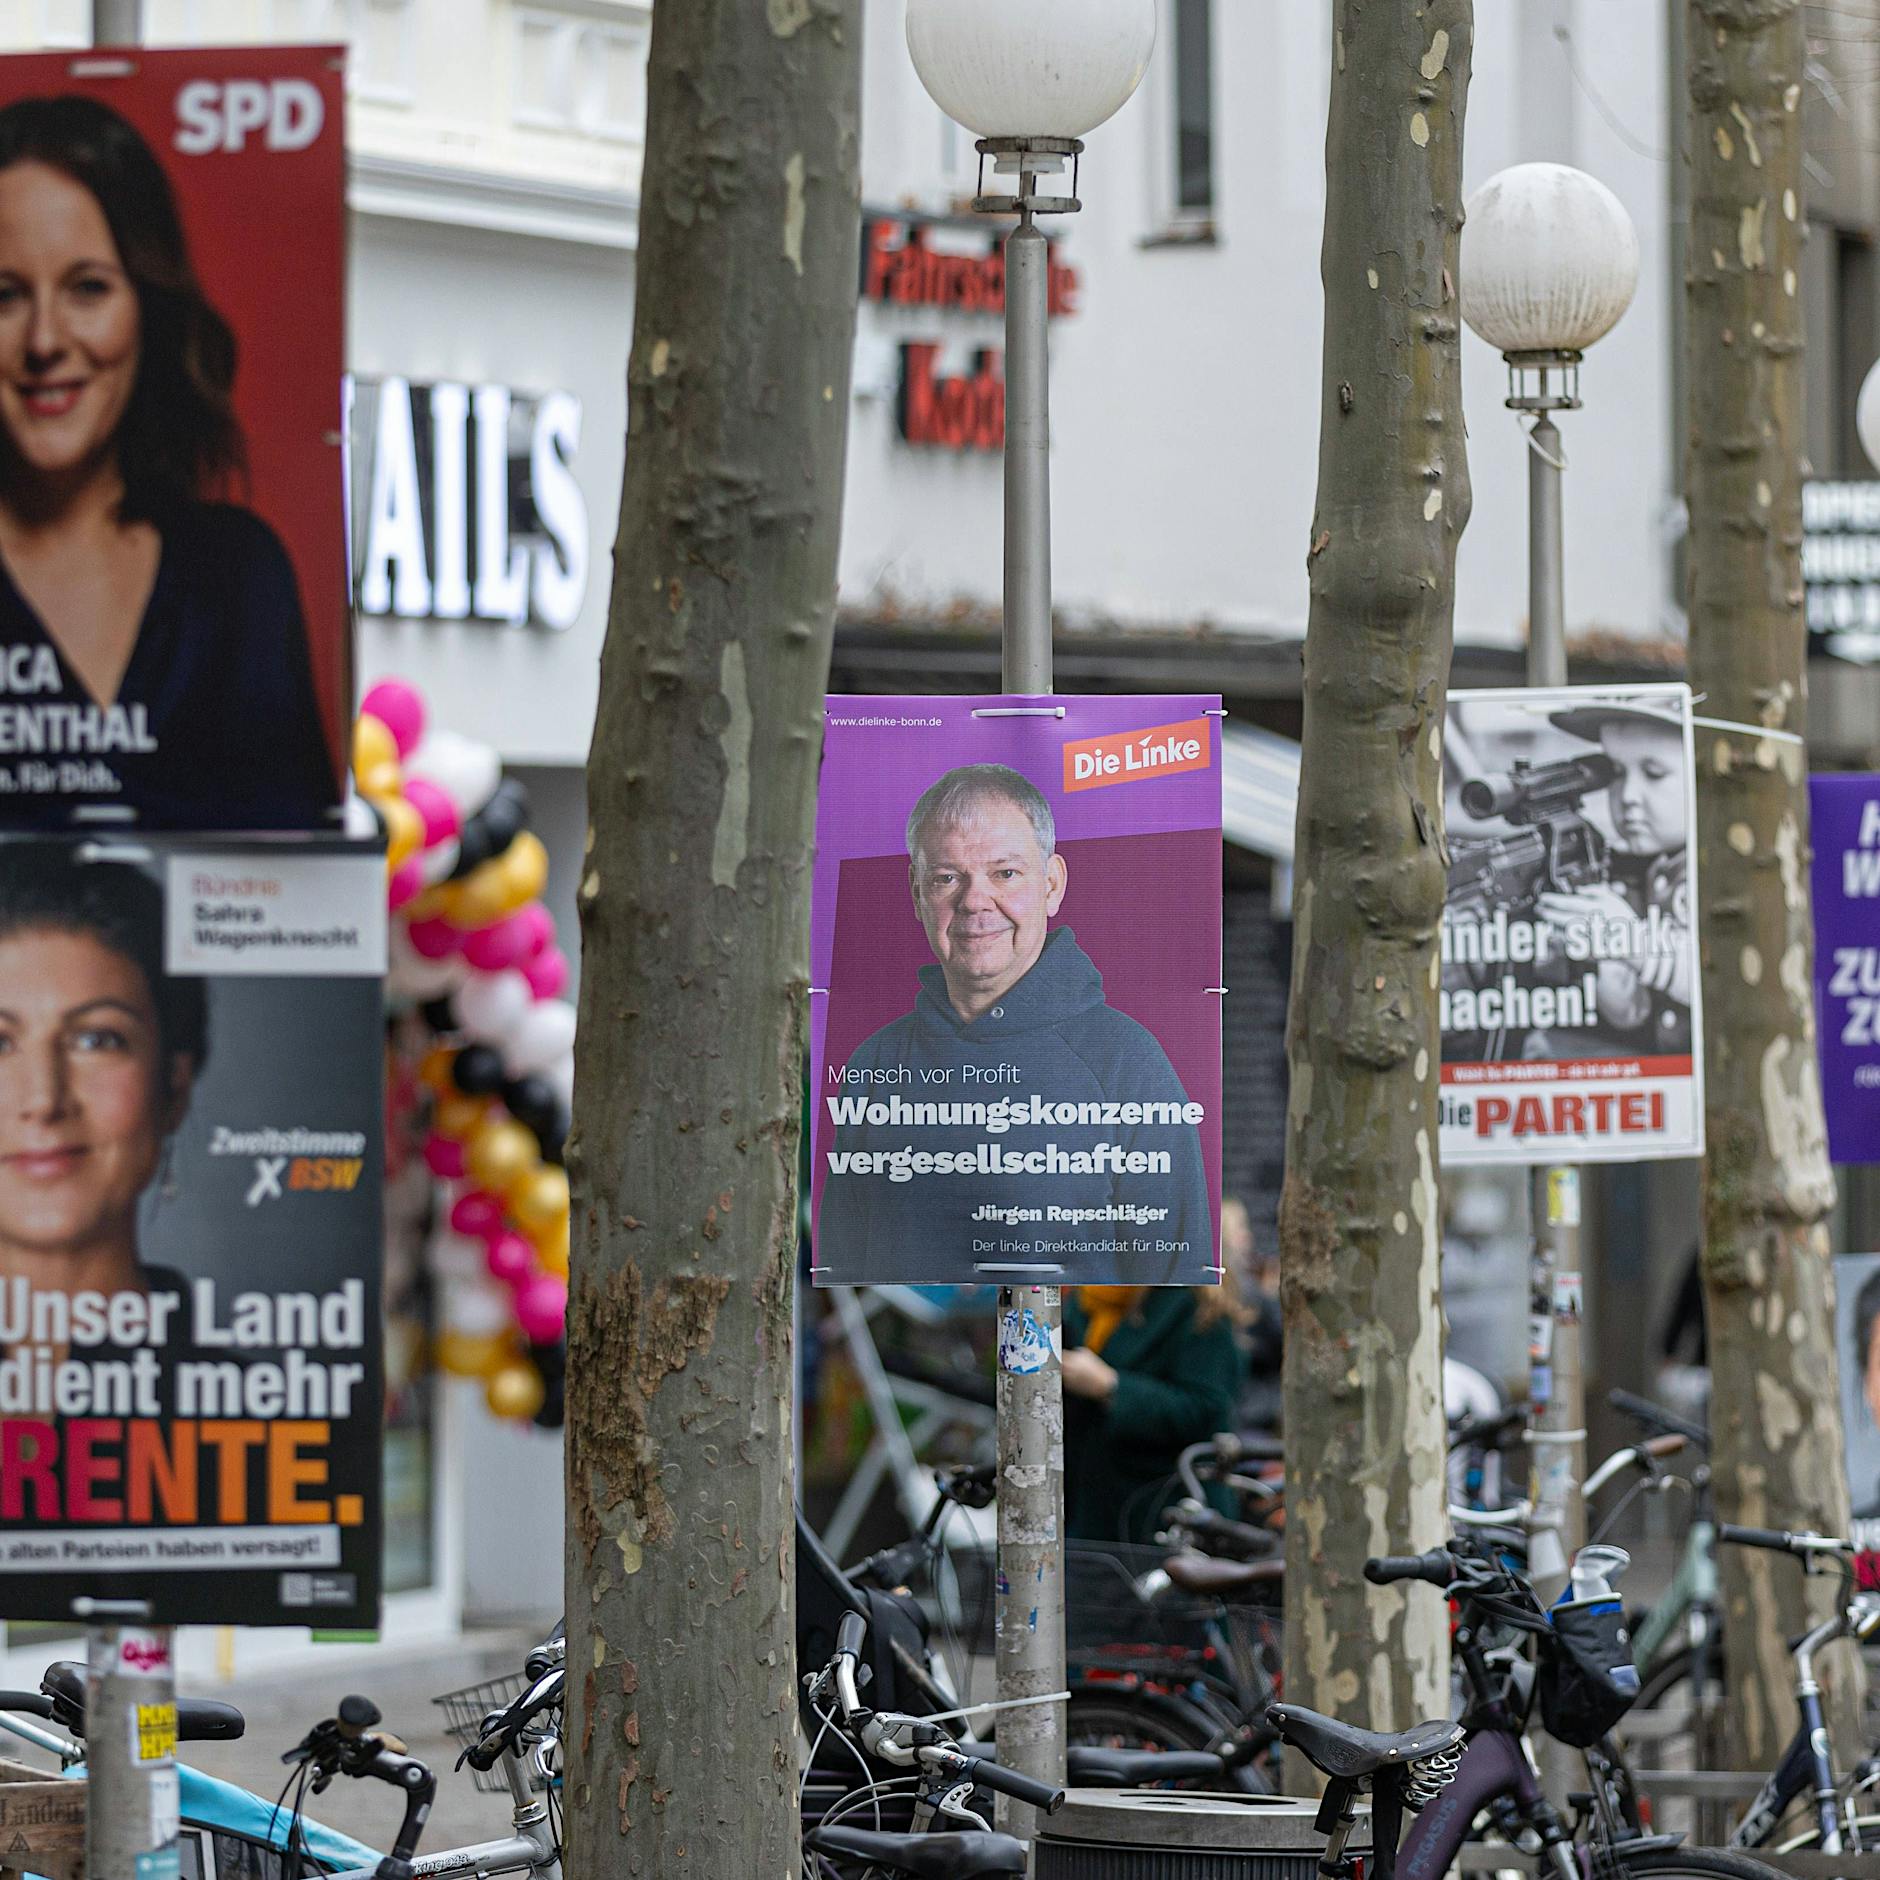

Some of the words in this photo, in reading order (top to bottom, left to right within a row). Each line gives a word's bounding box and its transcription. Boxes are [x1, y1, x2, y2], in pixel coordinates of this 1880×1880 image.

[175, 79, 325, 154] SPD
[342, 374, 590, 632] AILS
[0, 703, 158, 754] ENTHAL
[830, 716, 942, 728] www.dielinke-bonn.de
[1074, 747, 1121, 780] Die
[1125, 735, 1201, 771] Linke
[194, 903, 263, 923] Sahra
[1566, 904, 1676, 961] stark
[195, 928, 358, 952] Wagenknecht
[828, 1064, 912, 1085] Mensch
[920, 1068, 955, 1085] vor
[962, 1064, 1020, 1085] Profit
[827, 1095, 1205, 1133] Wohnungskonzerne
[1475, 1090, 1664, 1137] PARTEI
[209, 1126, 366, 1155] Zweitstimme
[288, 1157, 364, 1191] BSW
[827, 1142, 1171, 1182] vergesellschaften
[971, 1205, 1042, 1226] Jürgen
[1047, 1204, 1168, 1226] Repschläger
[972, 1239, 995, 1252] Der
[1000, 1238, 1030, 1252] linke
[1034, 1238, 1128, 1252] Direktkandidat
[1132, 1238, 1150, 1252] für
[1155, 1239, 1189, 1252] Bonn
[0, 1274, 180, 1347] Unser
[193, 1277, 365, 1349] Land
[175, 1349, 364, 1418] mehr
[0, 1420, 364, 1526] RENTE.
[9, 1541, 58, 1560] alten
[63, 1539, 150, 1560] Parteien
[157, 1538, 225, 1558] haben
[231, 1536, 321, 1560] versagt!
[1406, 1798, 1458, 1876] PEGASUS
